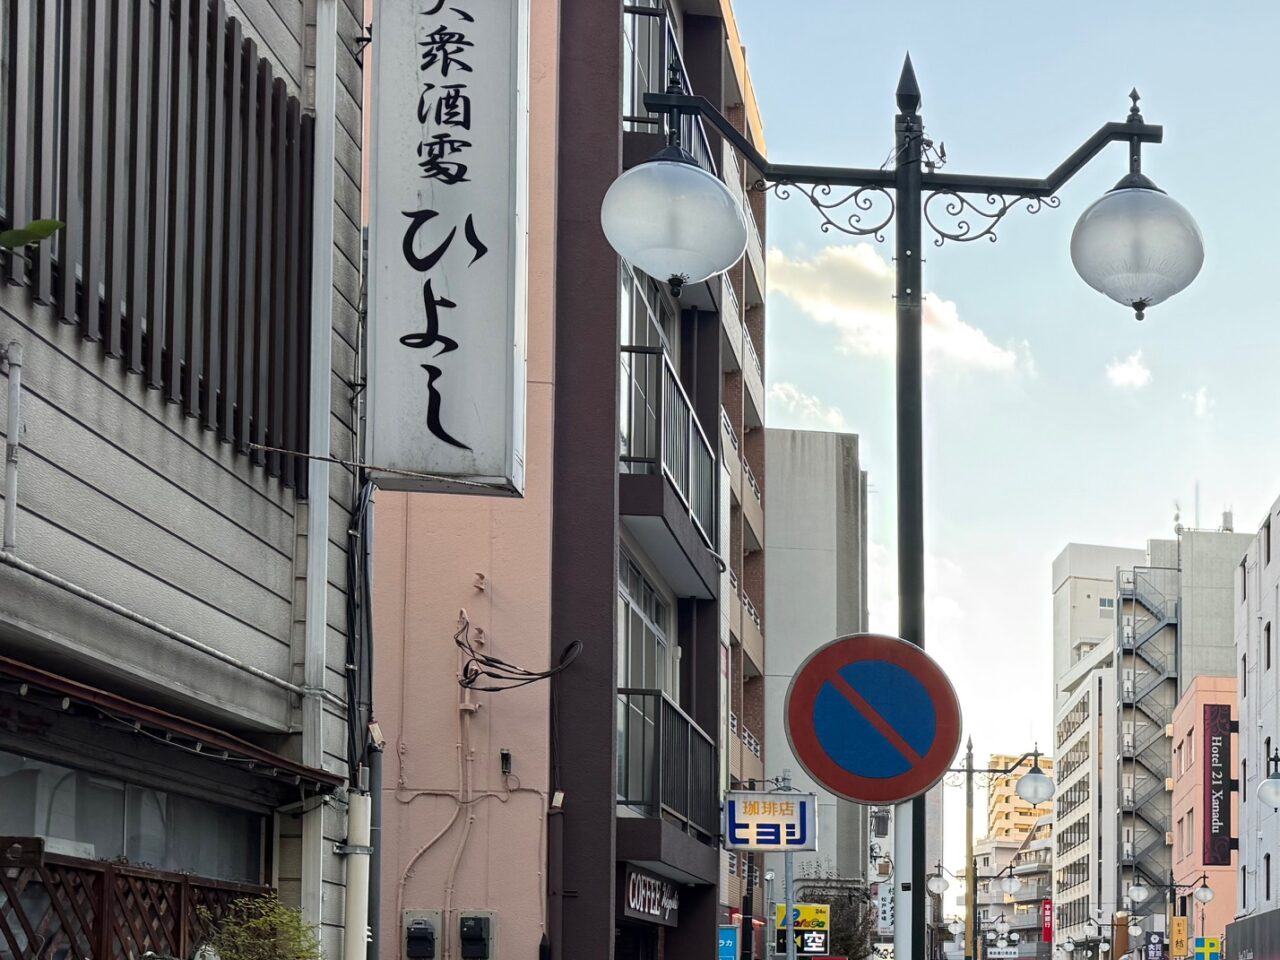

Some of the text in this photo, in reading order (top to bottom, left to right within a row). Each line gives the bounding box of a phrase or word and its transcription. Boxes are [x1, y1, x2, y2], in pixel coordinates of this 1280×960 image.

[400, 209, 489, 451] ひよし
[1211, 736, 1223, 834] Hotel 21 Xanadu
[728, 800, 807, 845] ヒヨシ
[742, 800, 795, 816] 珈琲店
[629, 872, 661, 916] COFFEE
[803, 931, 825, 952] 空
